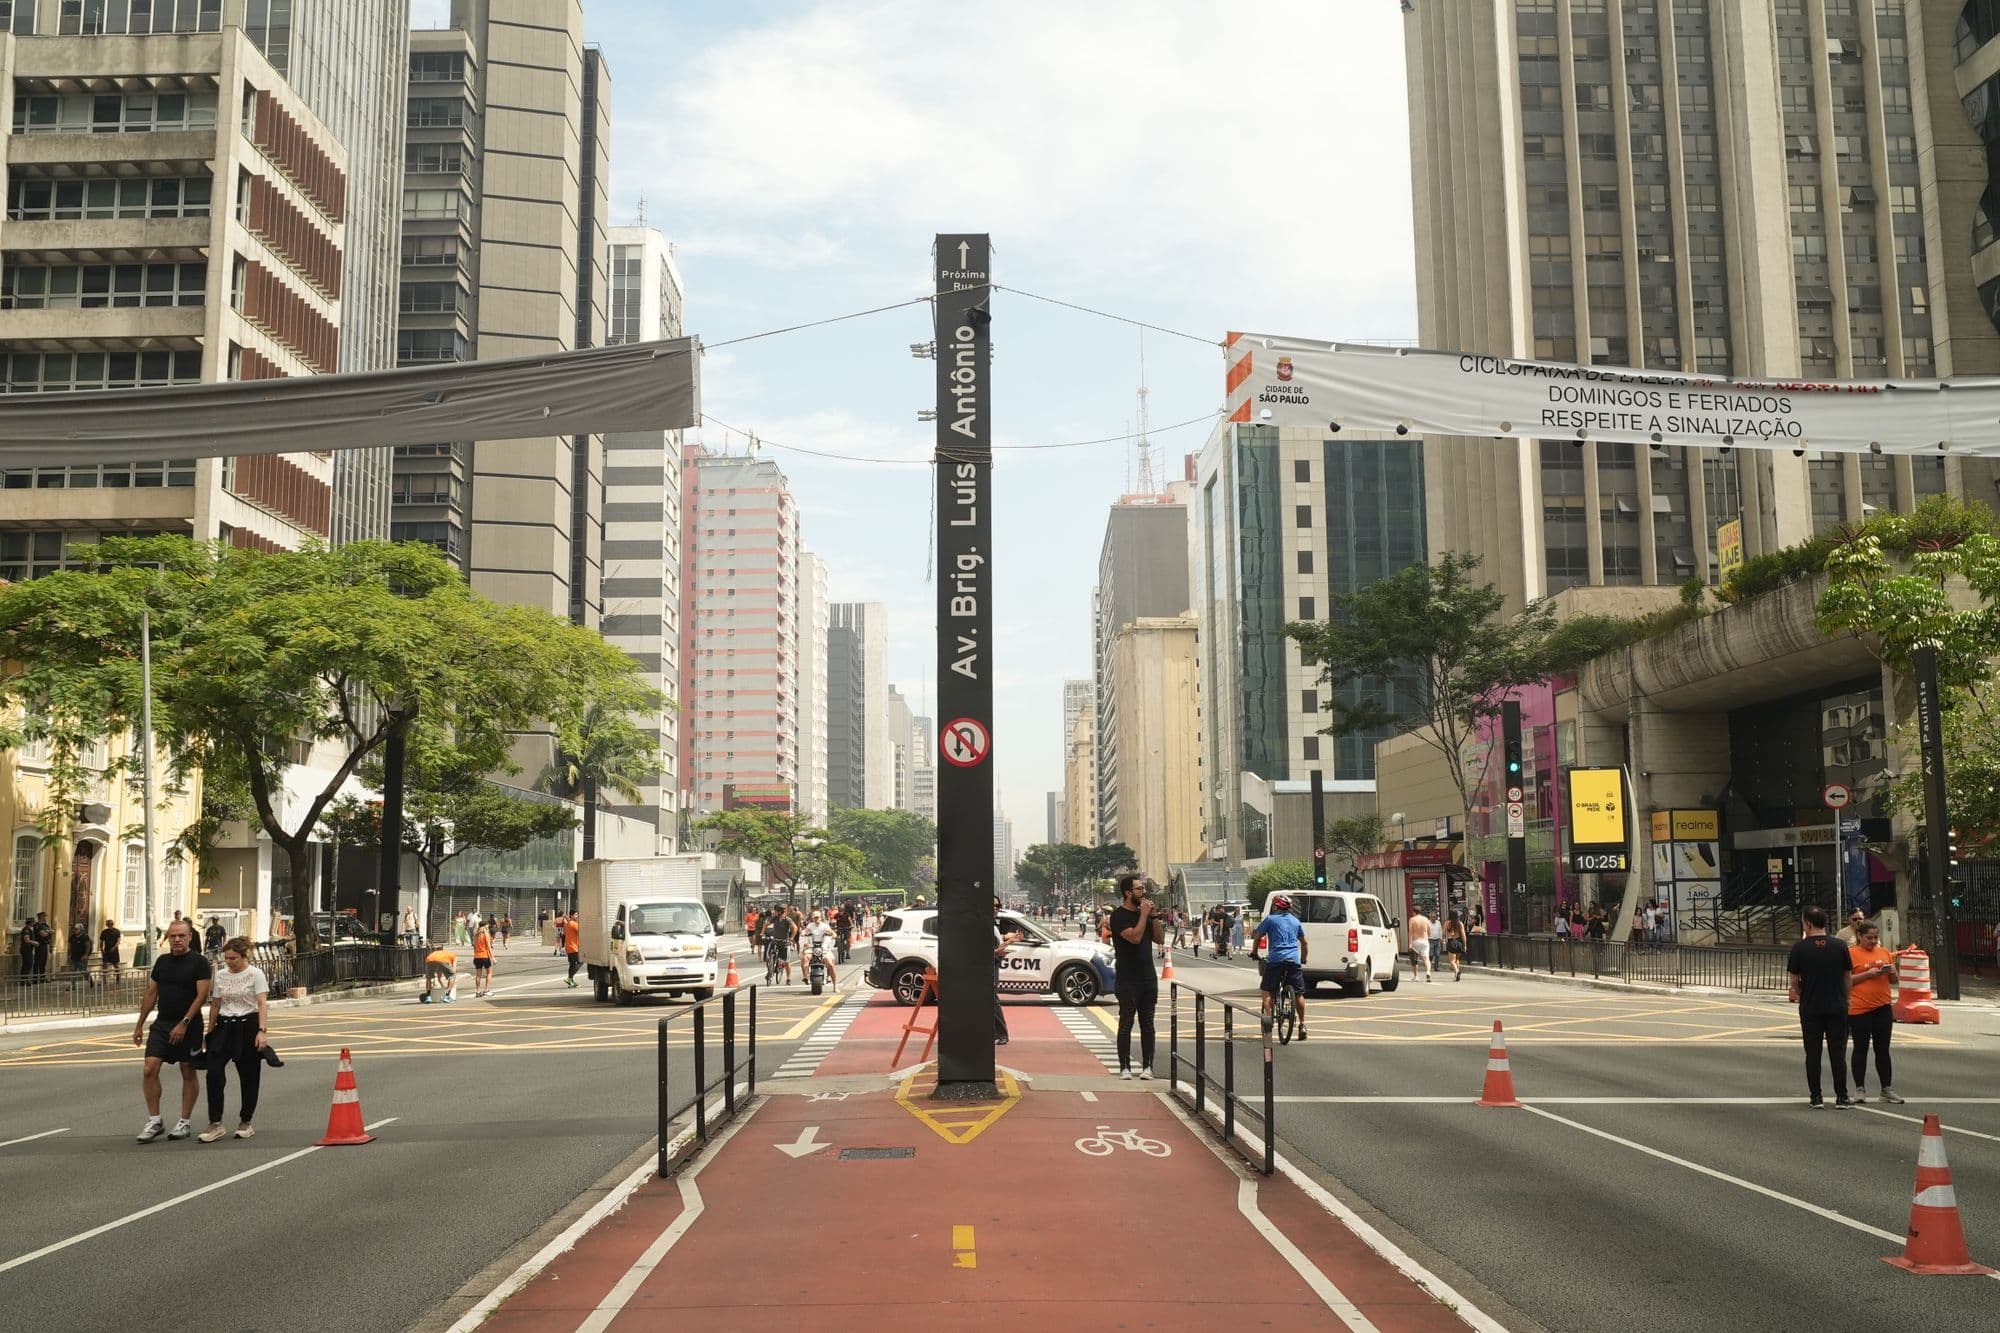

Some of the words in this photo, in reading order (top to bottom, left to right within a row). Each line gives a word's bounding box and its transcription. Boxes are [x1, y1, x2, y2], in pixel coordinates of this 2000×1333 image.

[942, 269, 985, 280] Próxima
[953, 282, 974, 291] Rua
[949, 325, 977, 439] Antônio
[1264, 384, 1291, 395] CIDADE
[1292, 386, 1304, 395] DE
[1258, 392, 1278, 405] SÃO
[1279, 394, 1310, 406] PAULO
[1548, 385, 1663, 410] DOMINGOS
[1669, 392, 1681, 409] E
[1687, 393, 1793, 415] FERIADOS
[1541, 408, 1644, 432] RESPEITE
[1647, 413, 1663, 432] A
[1666, 414, 1804, 441] SINALIZAÇÃO
[950, 462, 977, 527] Luís
[950, 545, 985, 618] Brig.
[950, 629, 978, 680] Av.
[1918, 680, 1930, 745] Paulista
[1509, 789, 1520, 798] 50
[1676, 820, 1714, 830] realme
[1577, 855, 1618, 869] 10:25
[1488, 883, 1497, 914] marisa
[1693, 890, 1710, 898] ANO
[998, 958, 1041, 971] GCM
